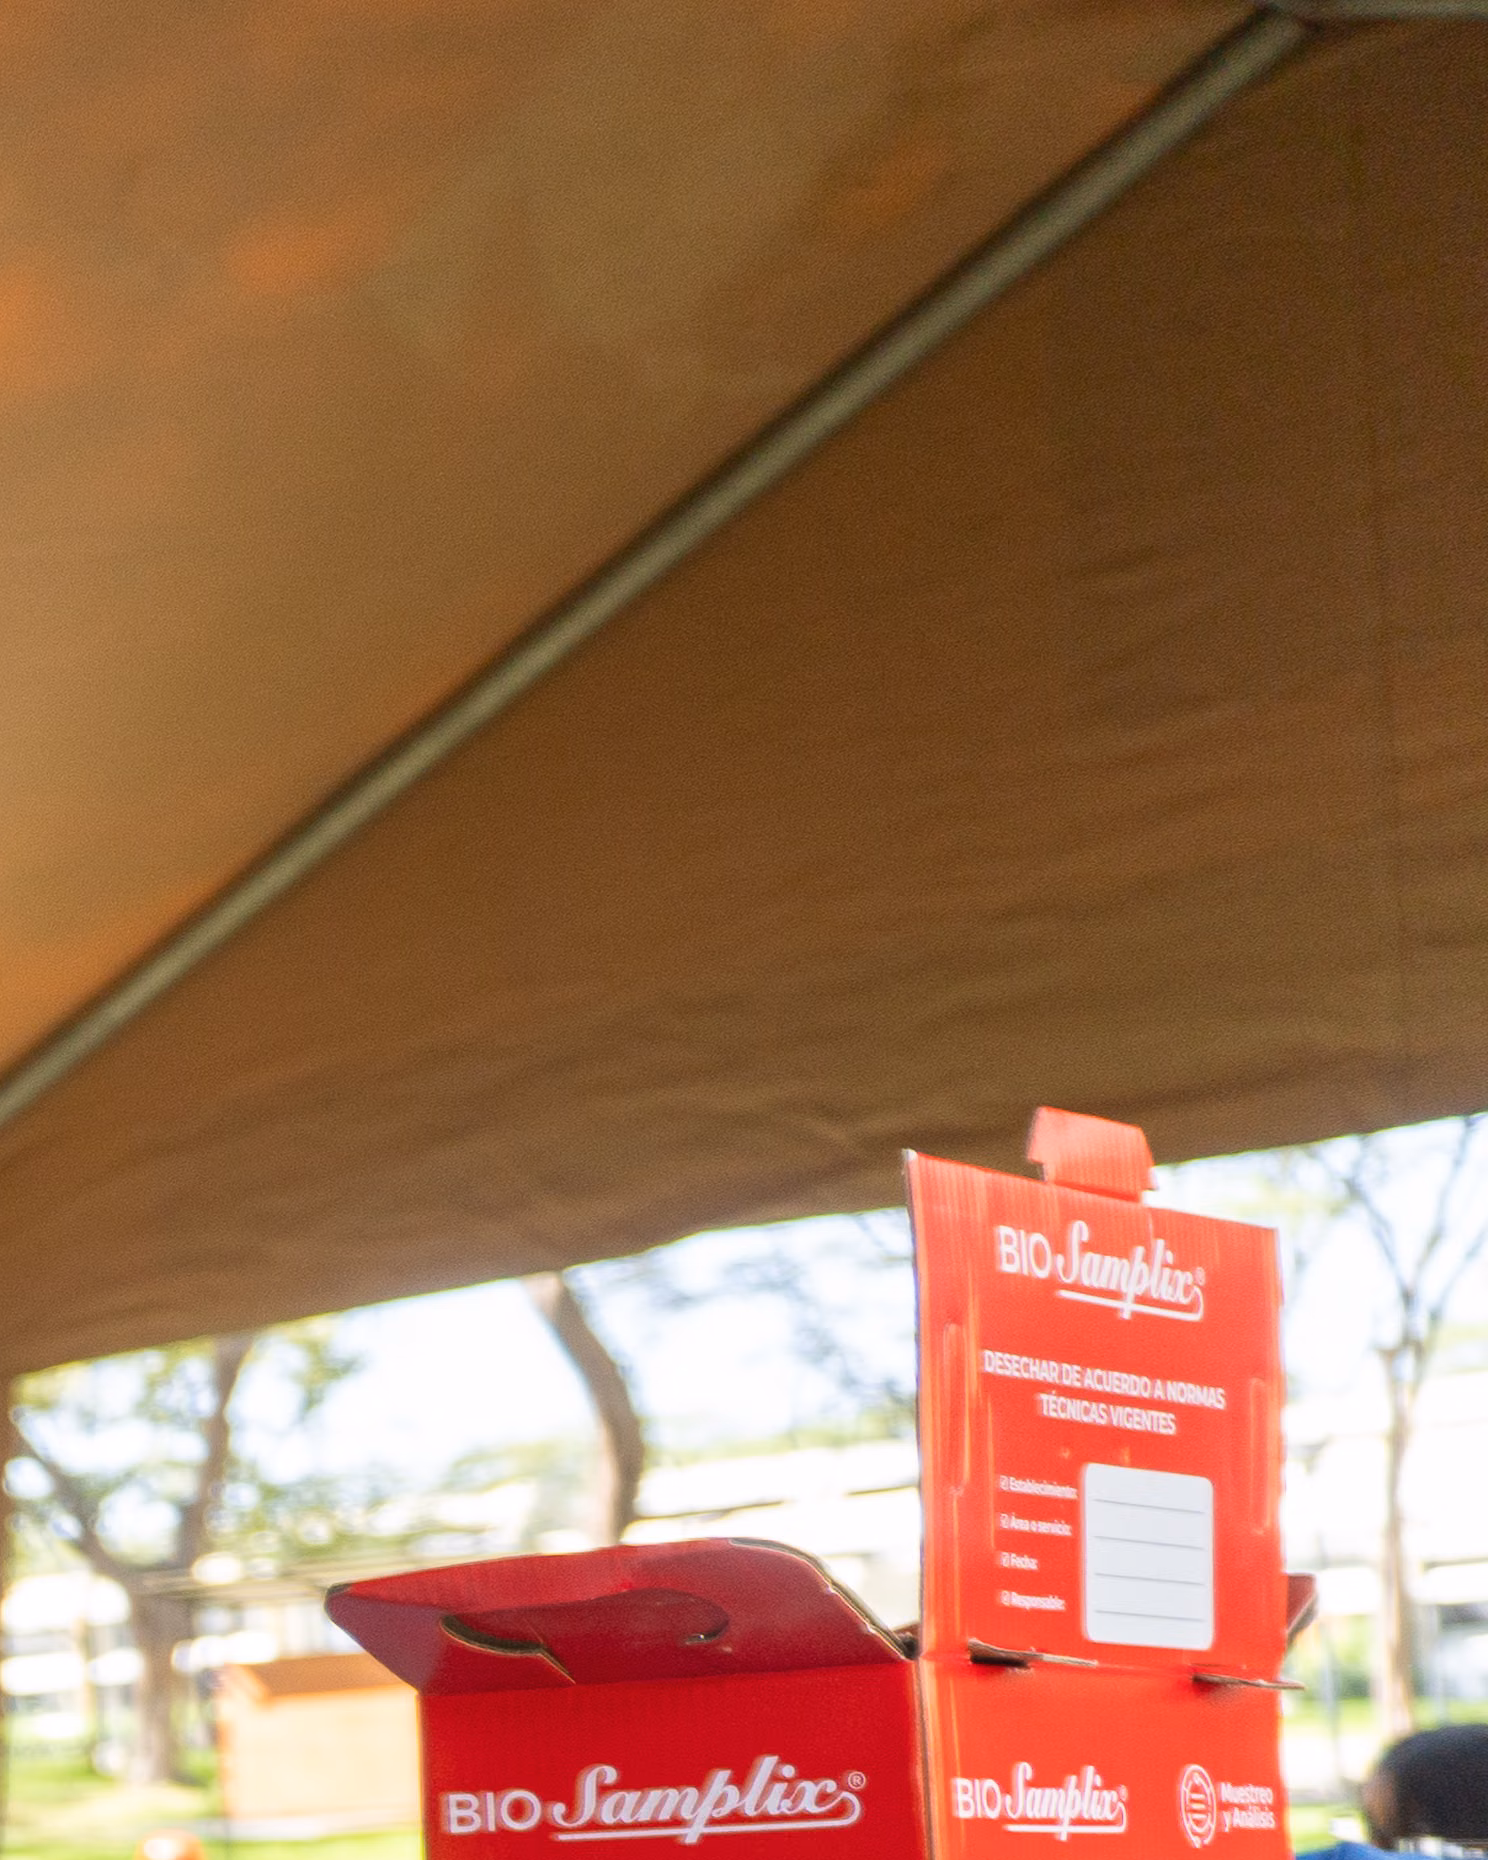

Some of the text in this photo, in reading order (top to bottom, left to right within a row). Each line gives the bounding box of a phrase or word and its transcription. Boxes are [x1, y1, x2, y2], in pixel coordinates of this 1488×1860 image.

[997, 1225, 1051, 1279] BIO
[984, 1350, 1226, 1410] DESECHAR DE ACUERDO A NORMAS
[1040, 1391, 1176, 1436] TÉCNICAS VIGENTES
[448, 1790, 541, 1834] BIO
[955, 1779, 1000, 1818] BIO
[1220, 1782, 1273, 1804] Muestreo
[1223, 1813, 1232, 1832] y
